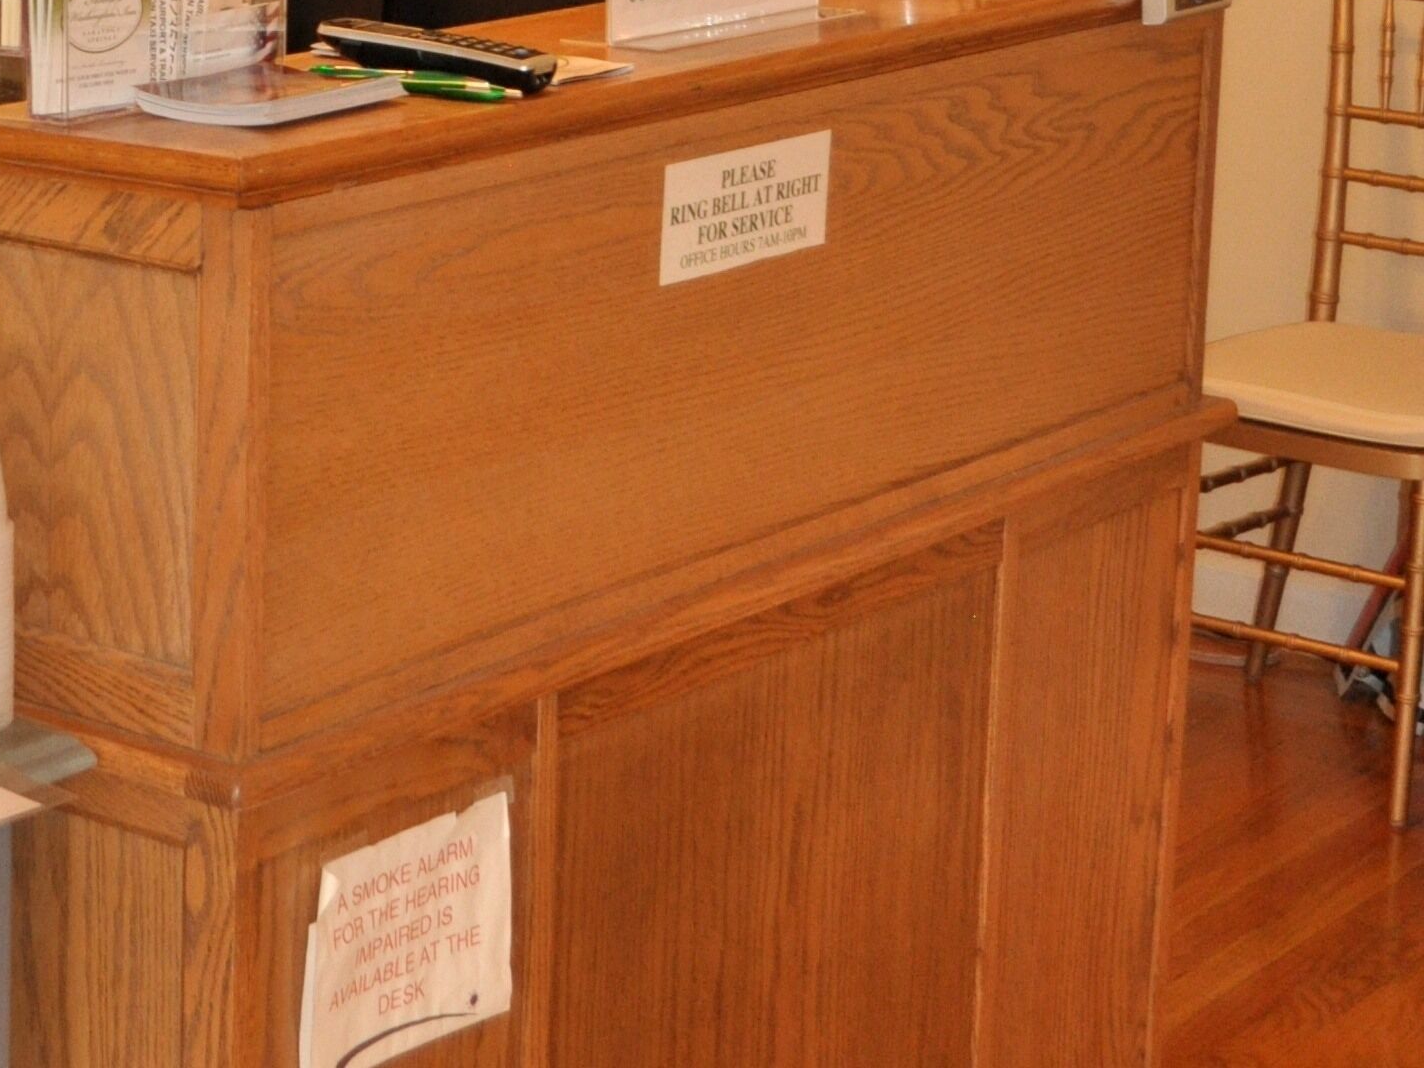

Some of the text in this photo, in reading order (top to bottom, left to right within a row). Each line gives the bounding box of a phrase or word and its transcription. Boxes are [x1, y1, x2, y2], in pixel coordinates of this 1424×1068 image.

[158, 0, 167, 45] AIRPORT
[721, 159, 777, 189] PLEASE
[670, 173, 822, 226] RING BELL AT RIGHT
[697, 204, 794, 245] FOR SERVICE
[679, 247, 718, 270] OFFICE
[719, 238, 756, 260] HOURS
[336, 836, 474, 914] A SMOKE ALARM
[332, 864, 481, 951] FOR THE HEARING
[354, 904, 454, 968] IMPAIRED IS
[329, 924, 482, 1012] AVAILABLE AT THE
[377, 978, 426, 1016] DESK
